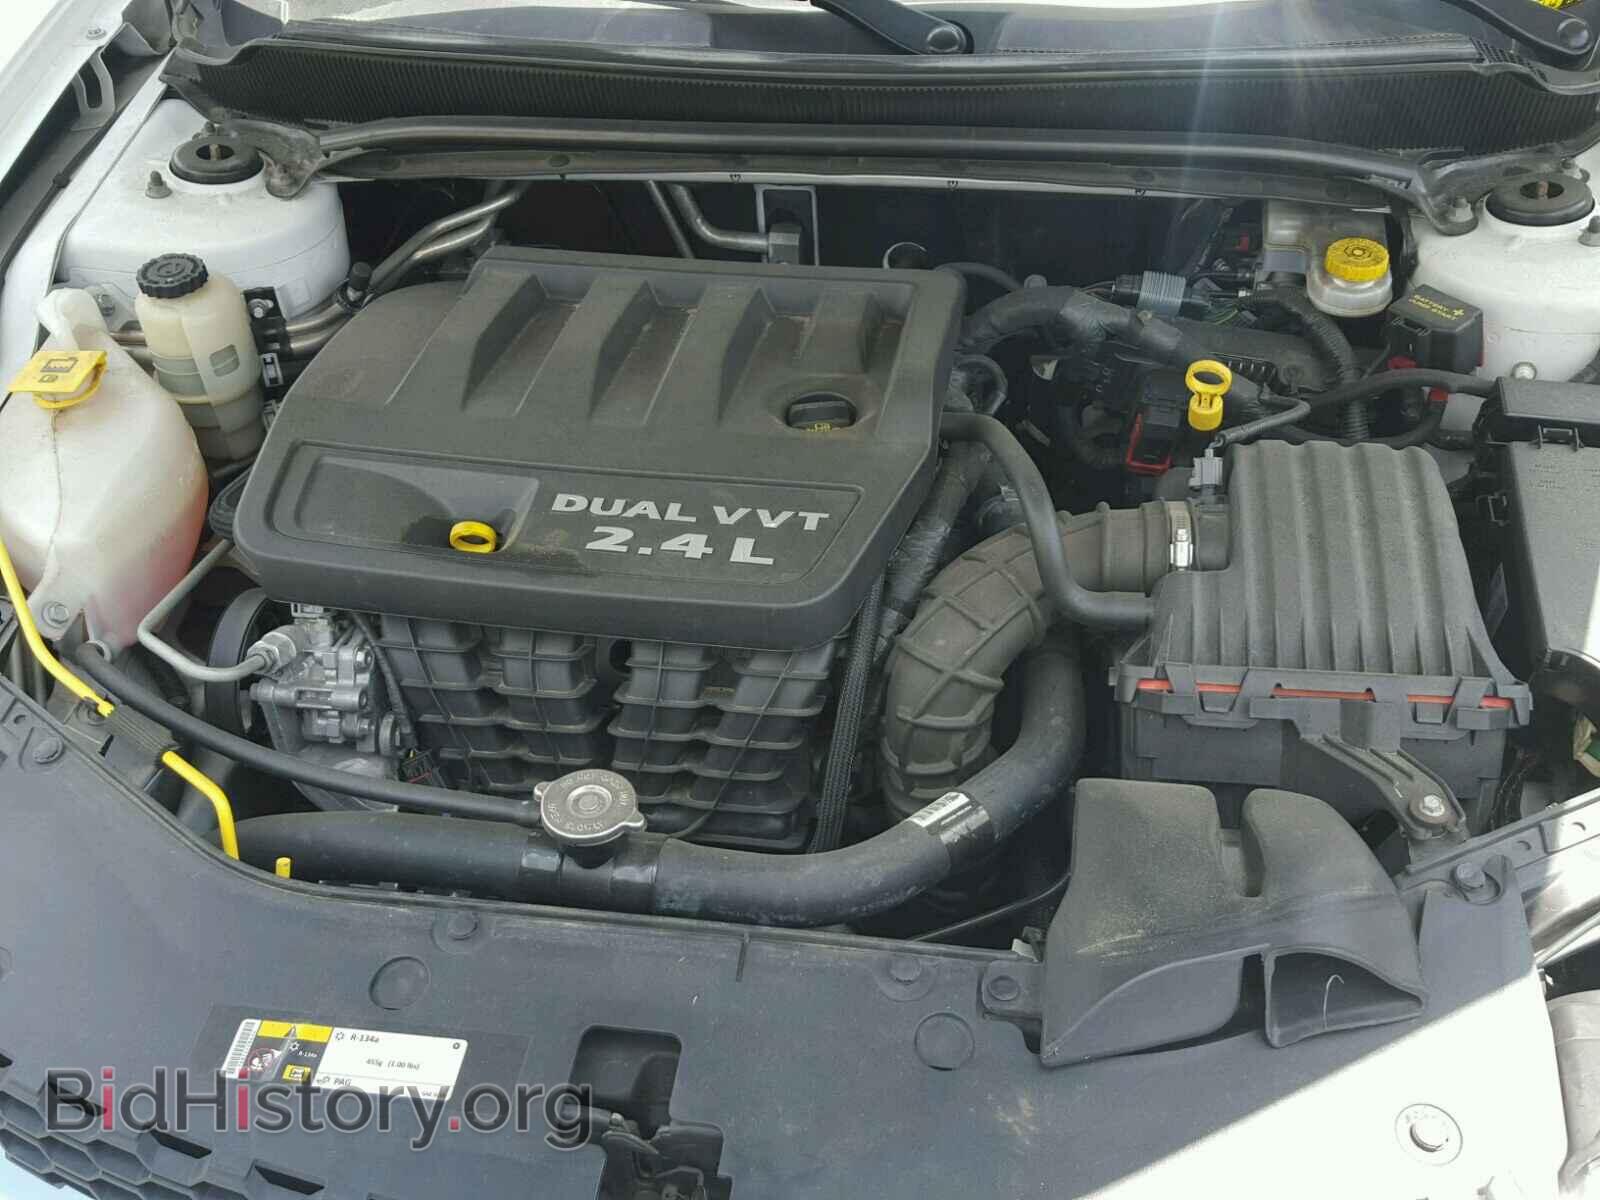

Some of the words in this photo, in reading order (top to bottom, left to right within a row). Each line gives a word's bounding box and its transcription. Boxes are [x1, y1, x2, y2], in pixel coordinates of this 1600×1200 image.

[551, 493, 697, 523] DUAL
[712, 505, 830, 531] VVT
[584, 525, 714, 560] 2.4
[729, 536, 774, 565] L
[350, 1032, 380, 1043] R-134a
[333, 1077, 352, 1087] PAG
